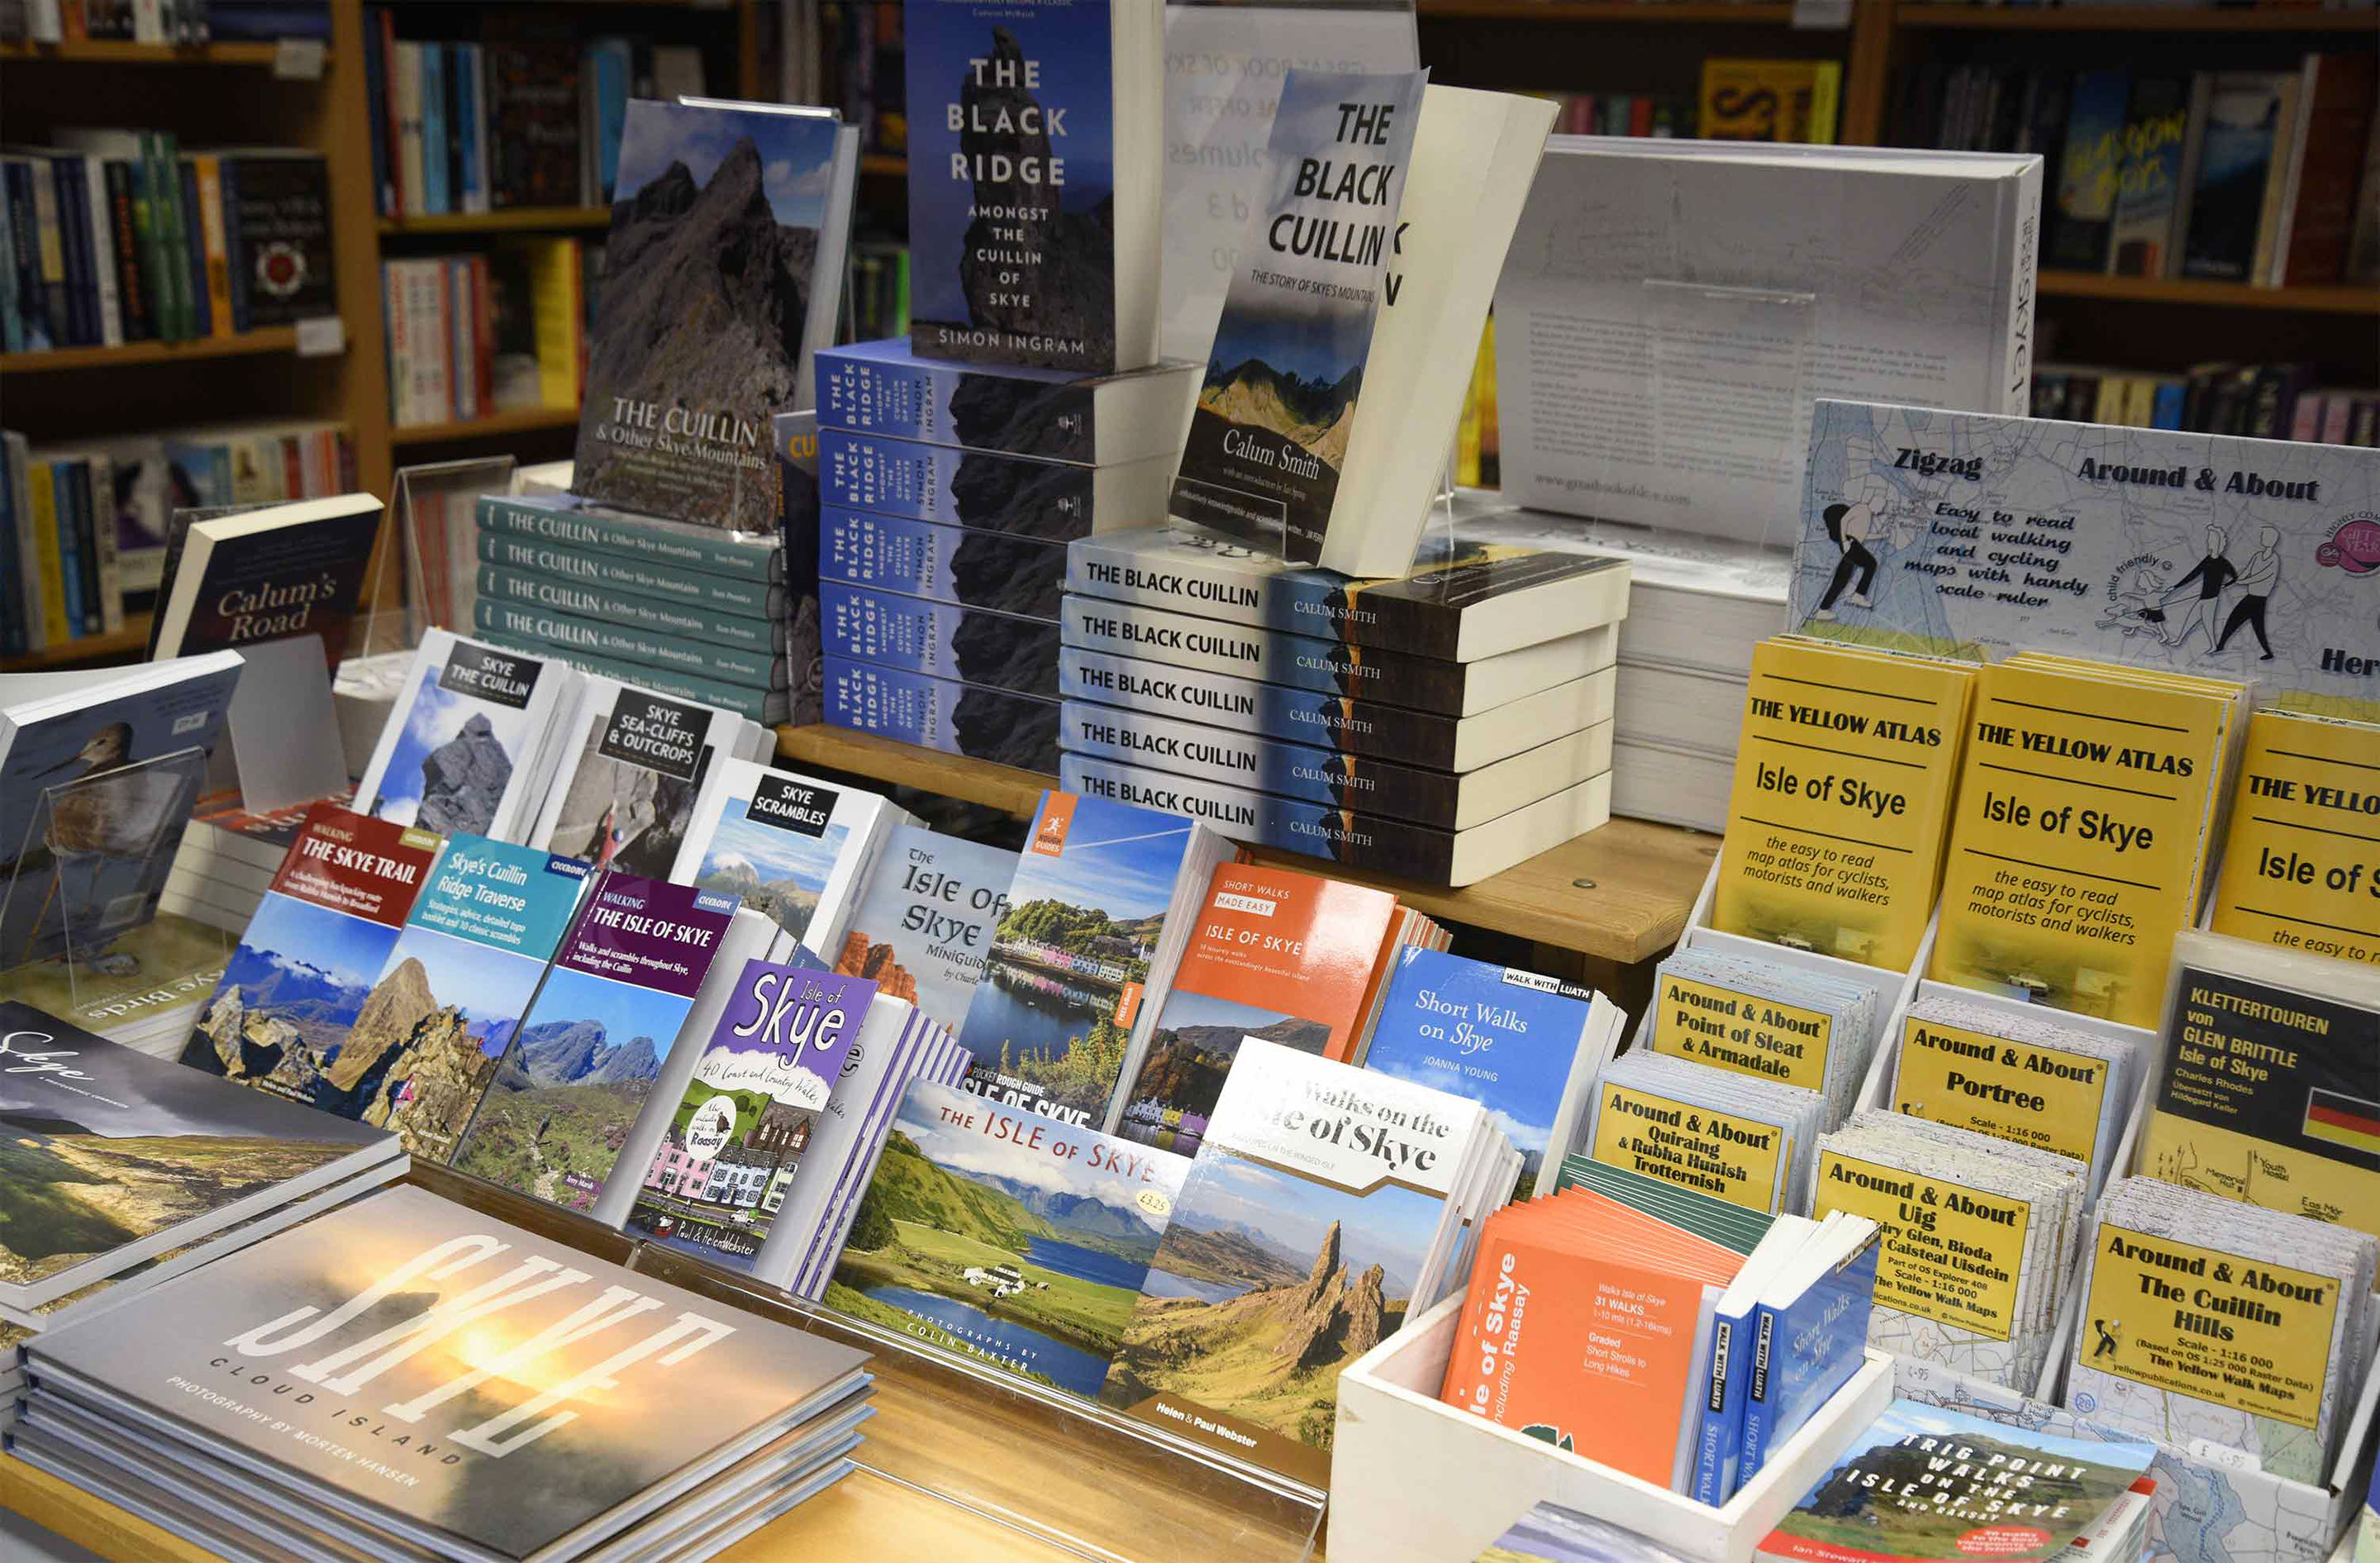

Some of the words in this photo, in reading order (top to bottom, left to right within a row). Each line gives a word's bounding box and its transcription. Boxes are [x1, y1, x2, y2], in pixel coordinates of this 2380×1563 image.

[969, 58, 1040, 88] THE
[947, 103, 1067, 136] BLACK
[1335, 102, 1394, 145] THE
[951, 153, 1064, 186] RIDGE
[1294, 158, 1395, 206] BLACK
[968, 206, 1049, 222] AMONGST
[993, 227, 1024, 241] THE
[1269, 213, 1385, 266] CUILLIN
[977, 249, 1041, 264] CUILLIN
[999, 272, 1021, 285] OF
[1252, 269, 1269, 284] THE
[1269, 273, 1297, 291] STORY
[1297, 279, 1311, 292] OF
[1311, 280, 1337, 298] SKYE'S
[990, 293, 1031, 308] SKYE
[939, 329, 1000, 348] SIMON
[1008, 335, 1085, 355] INGRAM
[614, 397, 659, 429] THE
[664, 406, 759, 447] CUILLIN
[1223, 428, 1276, 466] Calum
[1278, 443, 1321, 480] Smith
[1893, 447, 1983, 481] Zigzag
[2077, 457, 2187, 489] Around
[2194, 467, 2217, 492] &
[2225, 470, 2320, 502] About
[1935, 502, 1981, 523] Easy
[1993, 510, 2014, 523] to
[2026, 517, 2076, 531] read
[1930, 521, 1980, 538] local
[1992, 531, 2072, 554] walking
[1937, 545, 1977, 559] and
[1987, 551, 2060, 573] cycling
[218, 573, 336, 617] Calum's
[1086, 561, 1121, 584] THE
[1124, 569, 1183, 595] BLACK
[1187, 579, 1259, 608] CUILLIN
[1293, 600, 1335, 619] CALUM
[1337, 608, 1377, 625] SMITH
[1903, 560, 1957, 576] maps
[1968, 568, 2011, 584] with
[2024, 572, 2089, 597] handy
[1935, 584, 1985, 598] scale
[1997, 590, 2049, 608] ruler
[230, 603, 311, 641] Road
[451, 664, 480, 684] THE
[481, 670, 531, 698] CUILLIN
[481, 656, 516, 677] SKYE
[620, 714, 696, 746] SEA-CLIFFS
[646, 704, 683, 726] SKYE
[1751, 697, 1784, 720] THE
[1789, 704, 1868, 735] YELLOW
[1873, 720, 1942, 747] ATLAS
[608, 729, 620, 744] &
[623, 733, 695, 764] OUTCROPS
[781, 784, 815, 806] SKYE
[1756, 762, 1798, 796] Isle
[1806, 774, 1835, 803] of
[1840, 778, 1906, 818] Skye
[754, 795, 827, 827] SCRAMBLES
[302, 837, 333, 860] THE
[333, 846, 375, 873] SKYE
[375, 857, 417, 884] TRAIL
[448, 852, 486, 875] Skye's
[487, 861, 528, 886] Cuillin
[1766, 835, 1787, 851] the
[1790, 841, 1821, 860] easy
[1824, 846, 1837, 860] to
[1840, 851, 1875, 870] read
[1744, 865, 1803, 887] motorists
[1806, 879, 1833, 894] and
[1836, 885, 1891, 907] walkers
[1747, 850, 1775, 867] map
[1778, 856, 1811, 874] atlas
[1813, 861, 1835, 879] for
[1837, 867, 1891, 891] cyclists,
[438, 876, 474, 901] Ridge
[473, 884, 527, 912] Traverse
[1217, 895, 1245, 909] MADE
[1245, 901, 1271, 913] EASY
[1223, 880, 1254, 893] SHORT
[1256, 885, 1290, 900] WALKS
[593, 908, 622, 929] THE
[622, 913, 653, 936] ISLE
[654, 922, 674, 940] OF
[676, 925, 713, 948] SKYE
[902, 905, 982, 948] Skye
[1205, 924, 1235, 941] ISLE
[1239, 931, 1261, 946] OF
[1263, 936, 1303, 955] SKYE
[732, 972, 846, 1070] Skye
[1415, 990, 1468, 1018] Short
[1477, 1003, 1529, 1033] Walks
[2187, 1011, 2215, 1027] von
[2191, 987, 2330, 1036] KLETTERTOUREN
[1419, 1025, 1445, 1040] on
[1449, 1022, 1493, 1055] Skye
[1676, 1010, 1726, 1038] Point
[1730, 1027, 1751, 1045] of
[1754, 1032, 1804, 1060] Sleat
[2183, 1027, 2225, 1051] GLEN
[2230, 1037, 2298, 1070] BRITTLE
[1422, 1055, 1461, 1073] JOANNA
[1464, 1065, 1498, 1083] YOUNG
[1683, 1036, 1695, 1053] &
[1698, 1039, 1791, 1079] Armadale
[2179, 1045, 2205, 1066] Isle
[2211, 1056, 2226, 1071] of
[2230, 1059, 2268, 1082] Skye
[1946, 1071, 2045, 1113] Portree
[690, 1131, 725, 1149] Raasay
[939, 1106, 973, 1129] THE
[983, 1112, 1045, 1150] ISLE
[1052, 1141, 1078, 1160] OF
[1088, 1143, 1155, 1183] SKYE
[1309, 1115, 1353, 1146] of
[1349, 1122, 1437, 1172] Skye
[1648, 1126, 1721, 1160] Quiraing
[1634, 1156, 1726, 1194] Trotternish
[1139, 1193, 1166, 1211] £3.25
[1898, 1203, 1938, 1232] Uig
[1594, 1296, 1606, 1308] 31
[1608, 1299, 1645, 1316] WALKS
[2138, 1273, 2186, 1303] The
[2192, 1288, 2282, 1327] Cuillin
[1589, 1332, 1621, 1348] Graded
[2173, 1310, 2235, 1341] Hills
[223, 1235, 738, 1458] SKYE
[907, 1322, 956, 1348] COLIN
[967, 1342, 1029, 1373] BAXTER
[2113, 1362, 2226, 1401] yellowpublications.co.uk
[210, 1356, 315, 1404] CLOUD
[332, 1408, 461, 1467] ISLAND
[1156, 1401, 1185, 1422] Helen
[1185, 1413, 1193, 1424] &
[1193, 1416, 1216, 1434] Paul
[1216, 1422, 1258, 1449] Webster
[166, 1375, 274, 1428] PHOTOGRAPHY
[272, 1419, 293, 1434] BY
[293, 1429, 355, 1462] MORTEN
[356, 1456, 420, 1487] HANSEN
[1902, 1433, 1973, 1461] TRIG
[1988, 1453, 2088, 1480] POINT
[1928, 1456, 2035, 1489] WALKS
[1846, 1469, 1921, 1499] ISLE
[1933, 1491, 1971, 1508] OF
[1986, 1499, 2070, 1519] SKYE
